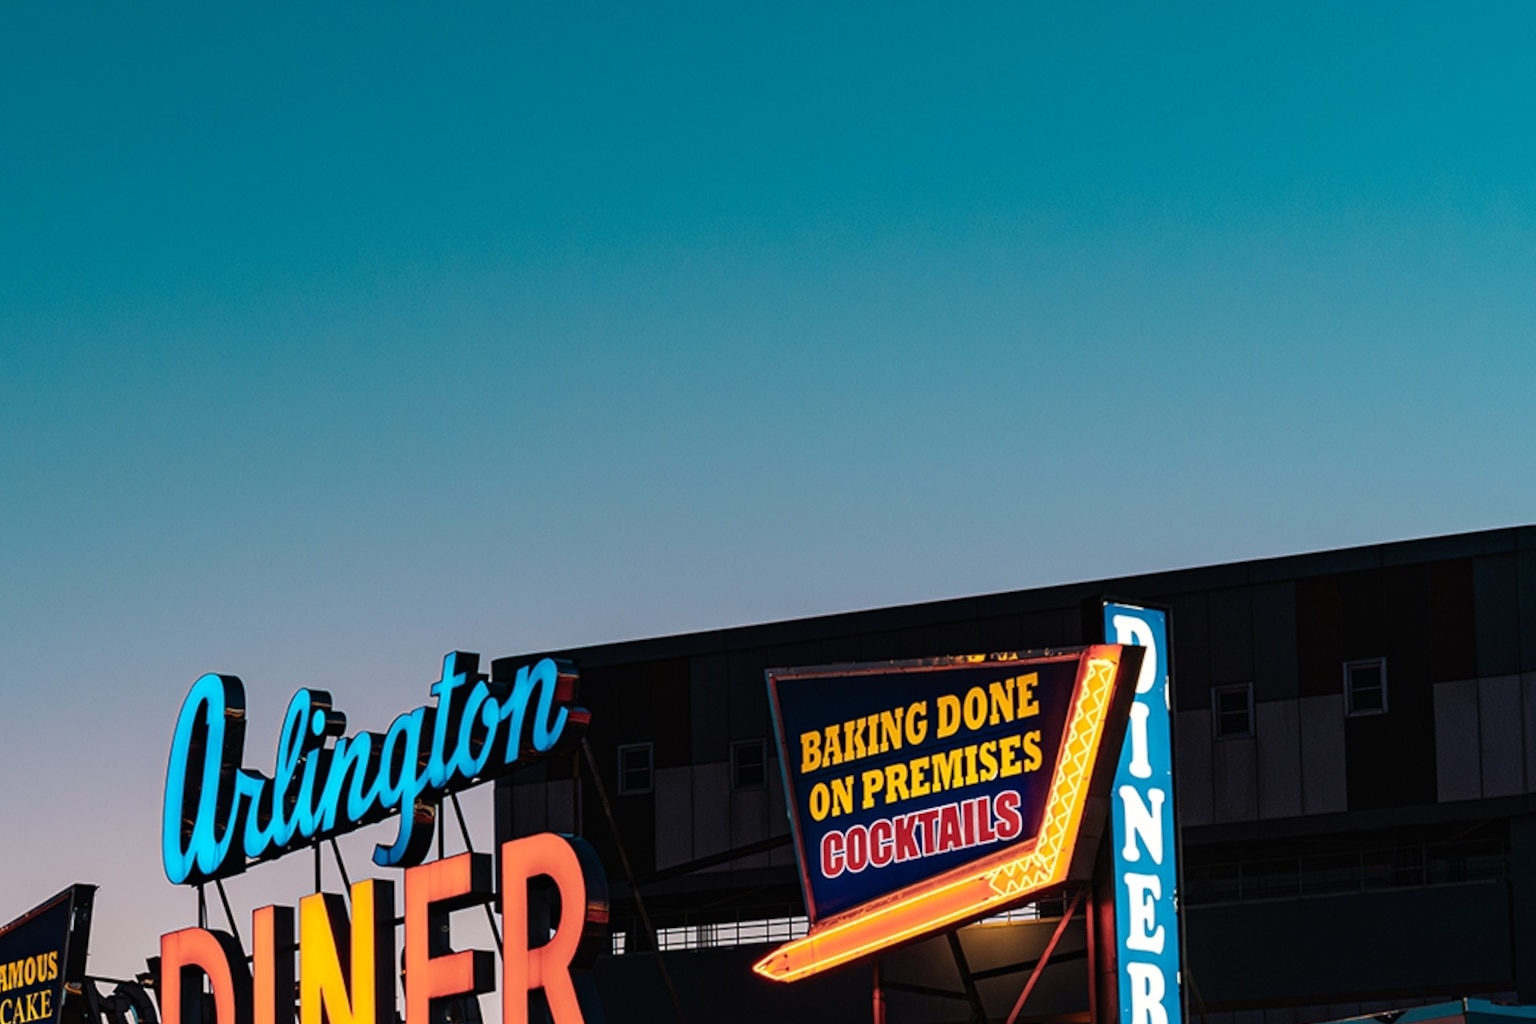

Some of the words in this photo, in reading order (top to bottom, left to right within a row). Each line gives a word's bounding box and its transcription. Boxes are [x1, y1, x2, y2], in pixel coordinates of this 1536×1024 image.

[162, 650, 569, 885] Arlington
[800, 701, 928, 774] BAKING
[936, 672, 1041, 740] DONE
[809, 775, 855, 822] ON
[861, 730, 1044, 810] PREMISES
[819, 790, 1023, 879] COCKTAILS
